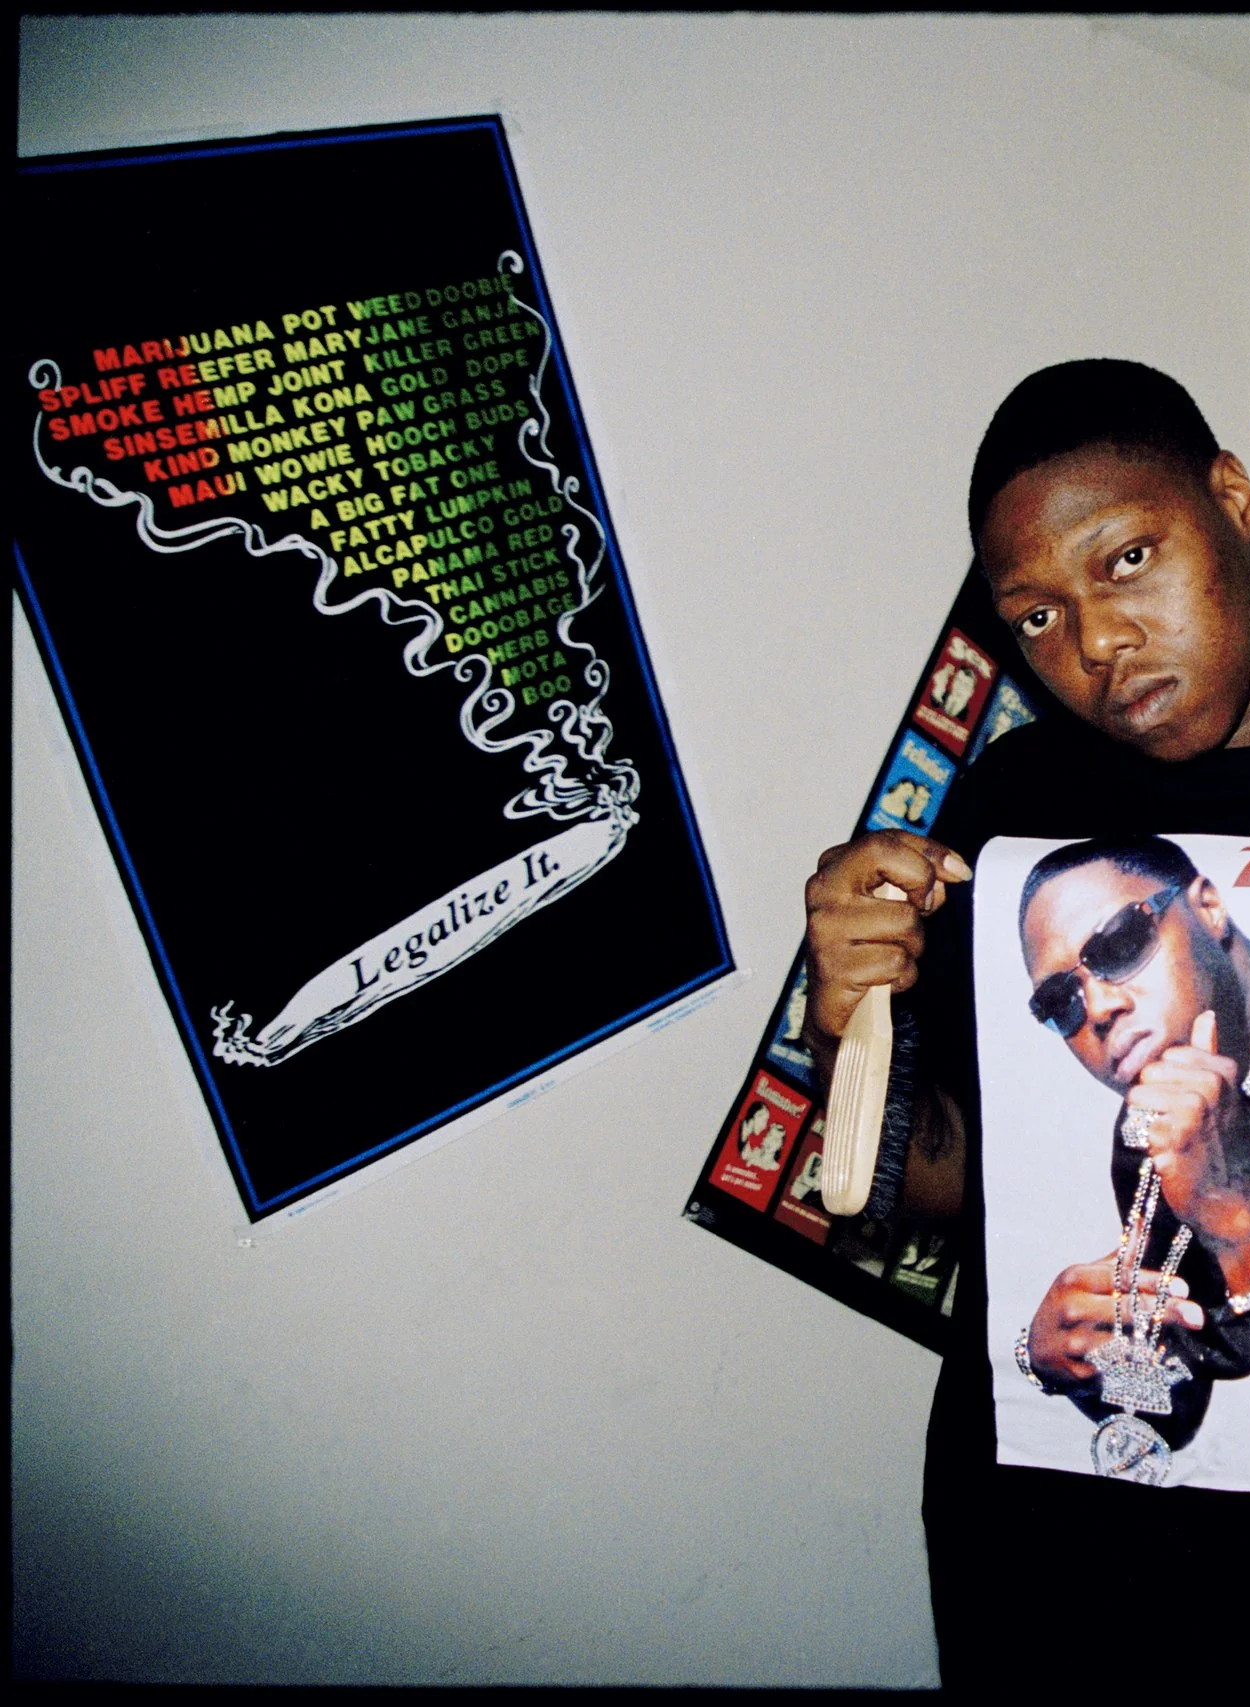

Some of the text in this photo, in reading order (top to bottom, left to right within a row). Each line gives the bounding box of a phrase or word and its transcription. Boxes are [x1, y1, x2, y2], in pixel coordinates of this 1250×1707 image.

[38, 297, 521, 412] SPLIFF REEFER MARY JANE GANJA
[93, 273, 514, 372] MARIJUANA POT WEED DOOBIE
[49, 319, 541, 441] SMOKE HEMP JOINT KILLER GREEN
[103, 348, 529, 461] SINSEMILLA KONA GOLD DOPE
[143, 379, 506, 482] KIND MONKEY PAW GRASS
[168, 400, 529, 508] MAUI WOWIE HOOCH BUDS
[261, 434, 495, 512] WACKY TOBACKY
[310, 460, 499, 530] A BIG FAT ONE
[330, 479, 532, 552] FATTY LUMPKIN
[344, 495, 563, 577] ALCAPULCO GOLD
[391, 524, 553, 589] PANAMA RED
[425, 548, 561, 604] THAI STICK
[444, 593, 576, 653] DOOOBAGE
[449, 570, 569, 624] CANNABIS
[487, 629, 550, 665] HERB
[501, 650, 567, 687] MOTA
[522, 674, 571, 705] BOO
[350, 851, 560, 994] Legalize It.
